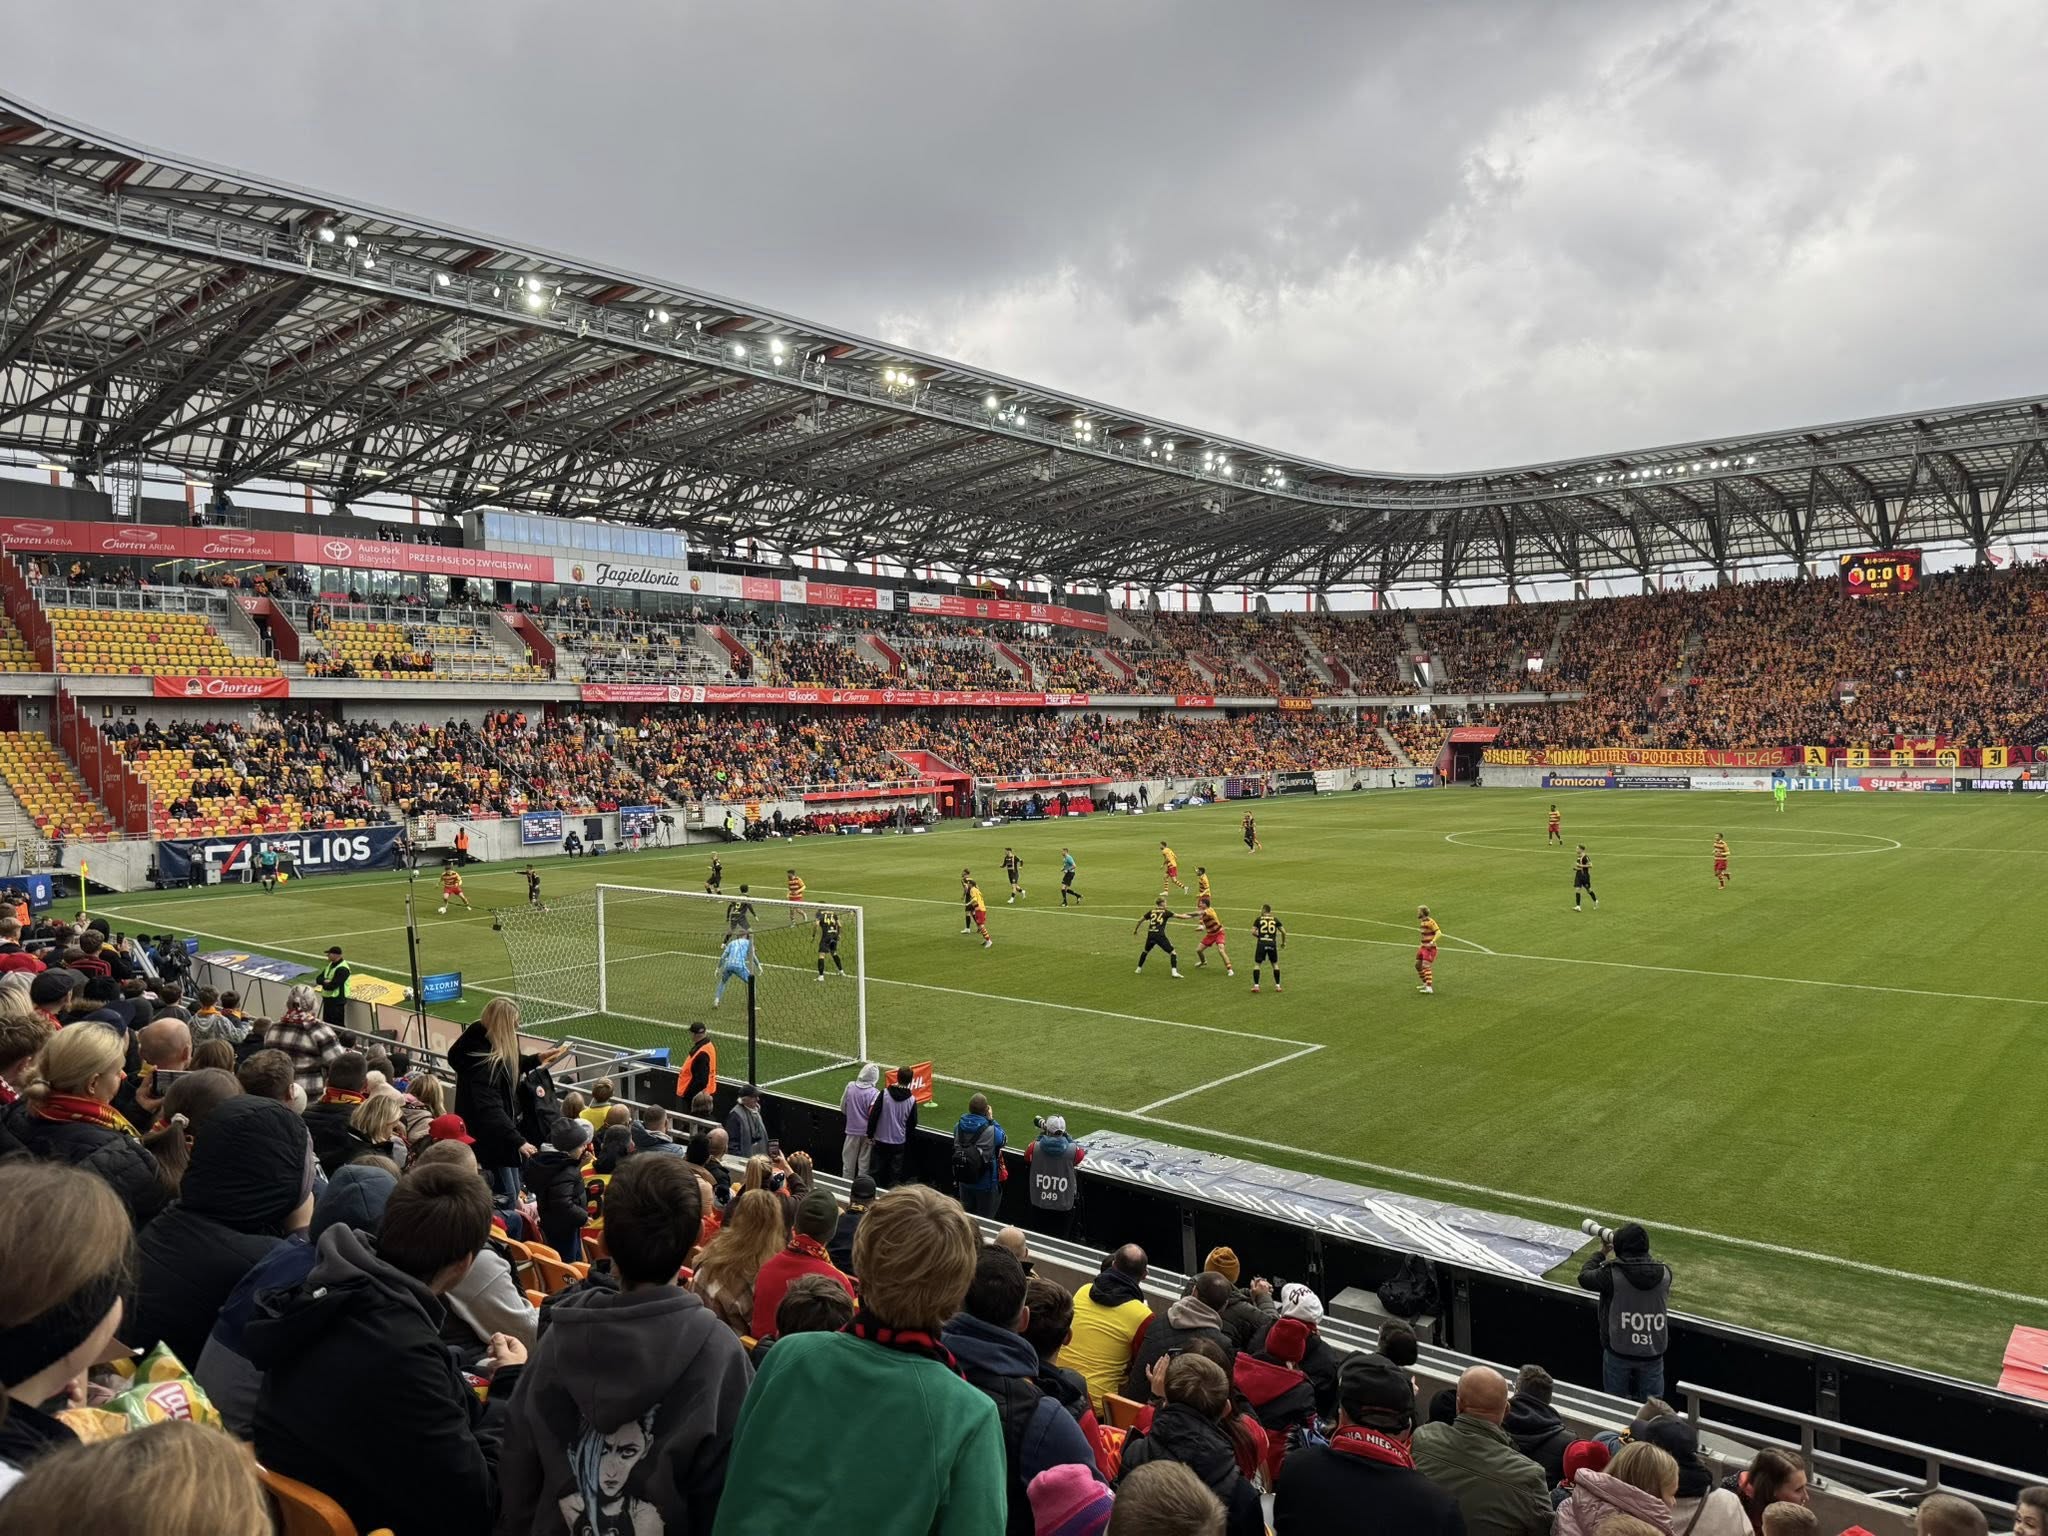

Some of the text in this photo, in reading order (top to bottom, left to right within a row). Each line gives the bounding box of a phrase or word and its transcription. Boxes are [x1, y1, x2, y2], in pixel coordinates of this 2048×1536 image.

[44, 538, 73, 546] ARENA
[102, 538, 176, 551] Chorten ARENA
[203, 543, 245, 555] Chorten
[358, 543, 401, 555] Auto Park
[408, 552, 532, 571] PRZEZ PASJĘ DO ZWYCIĘSTWA!
[596, 563, 680, 587] Jagiellonia
[244, 600, 258, 610] 37
[206, 679, 263, 696] Chorten
[1590, 750, 1707, 765] DUMA PODLASIA
[1708, 751, 1782, 766] ULTRAS
[1549, 777, 1606, 787] romicore
[1150, 913, 1164, 925] 24
[1259, 920, 1276, 934] 26
[424, 980, 459, 992] AZTORIN
[1036, 1174, 1068, 1192] FOTO
[1041, 1191, 1058, 1201] 049
[1621, 1312, 1665, 1331] FOTO
